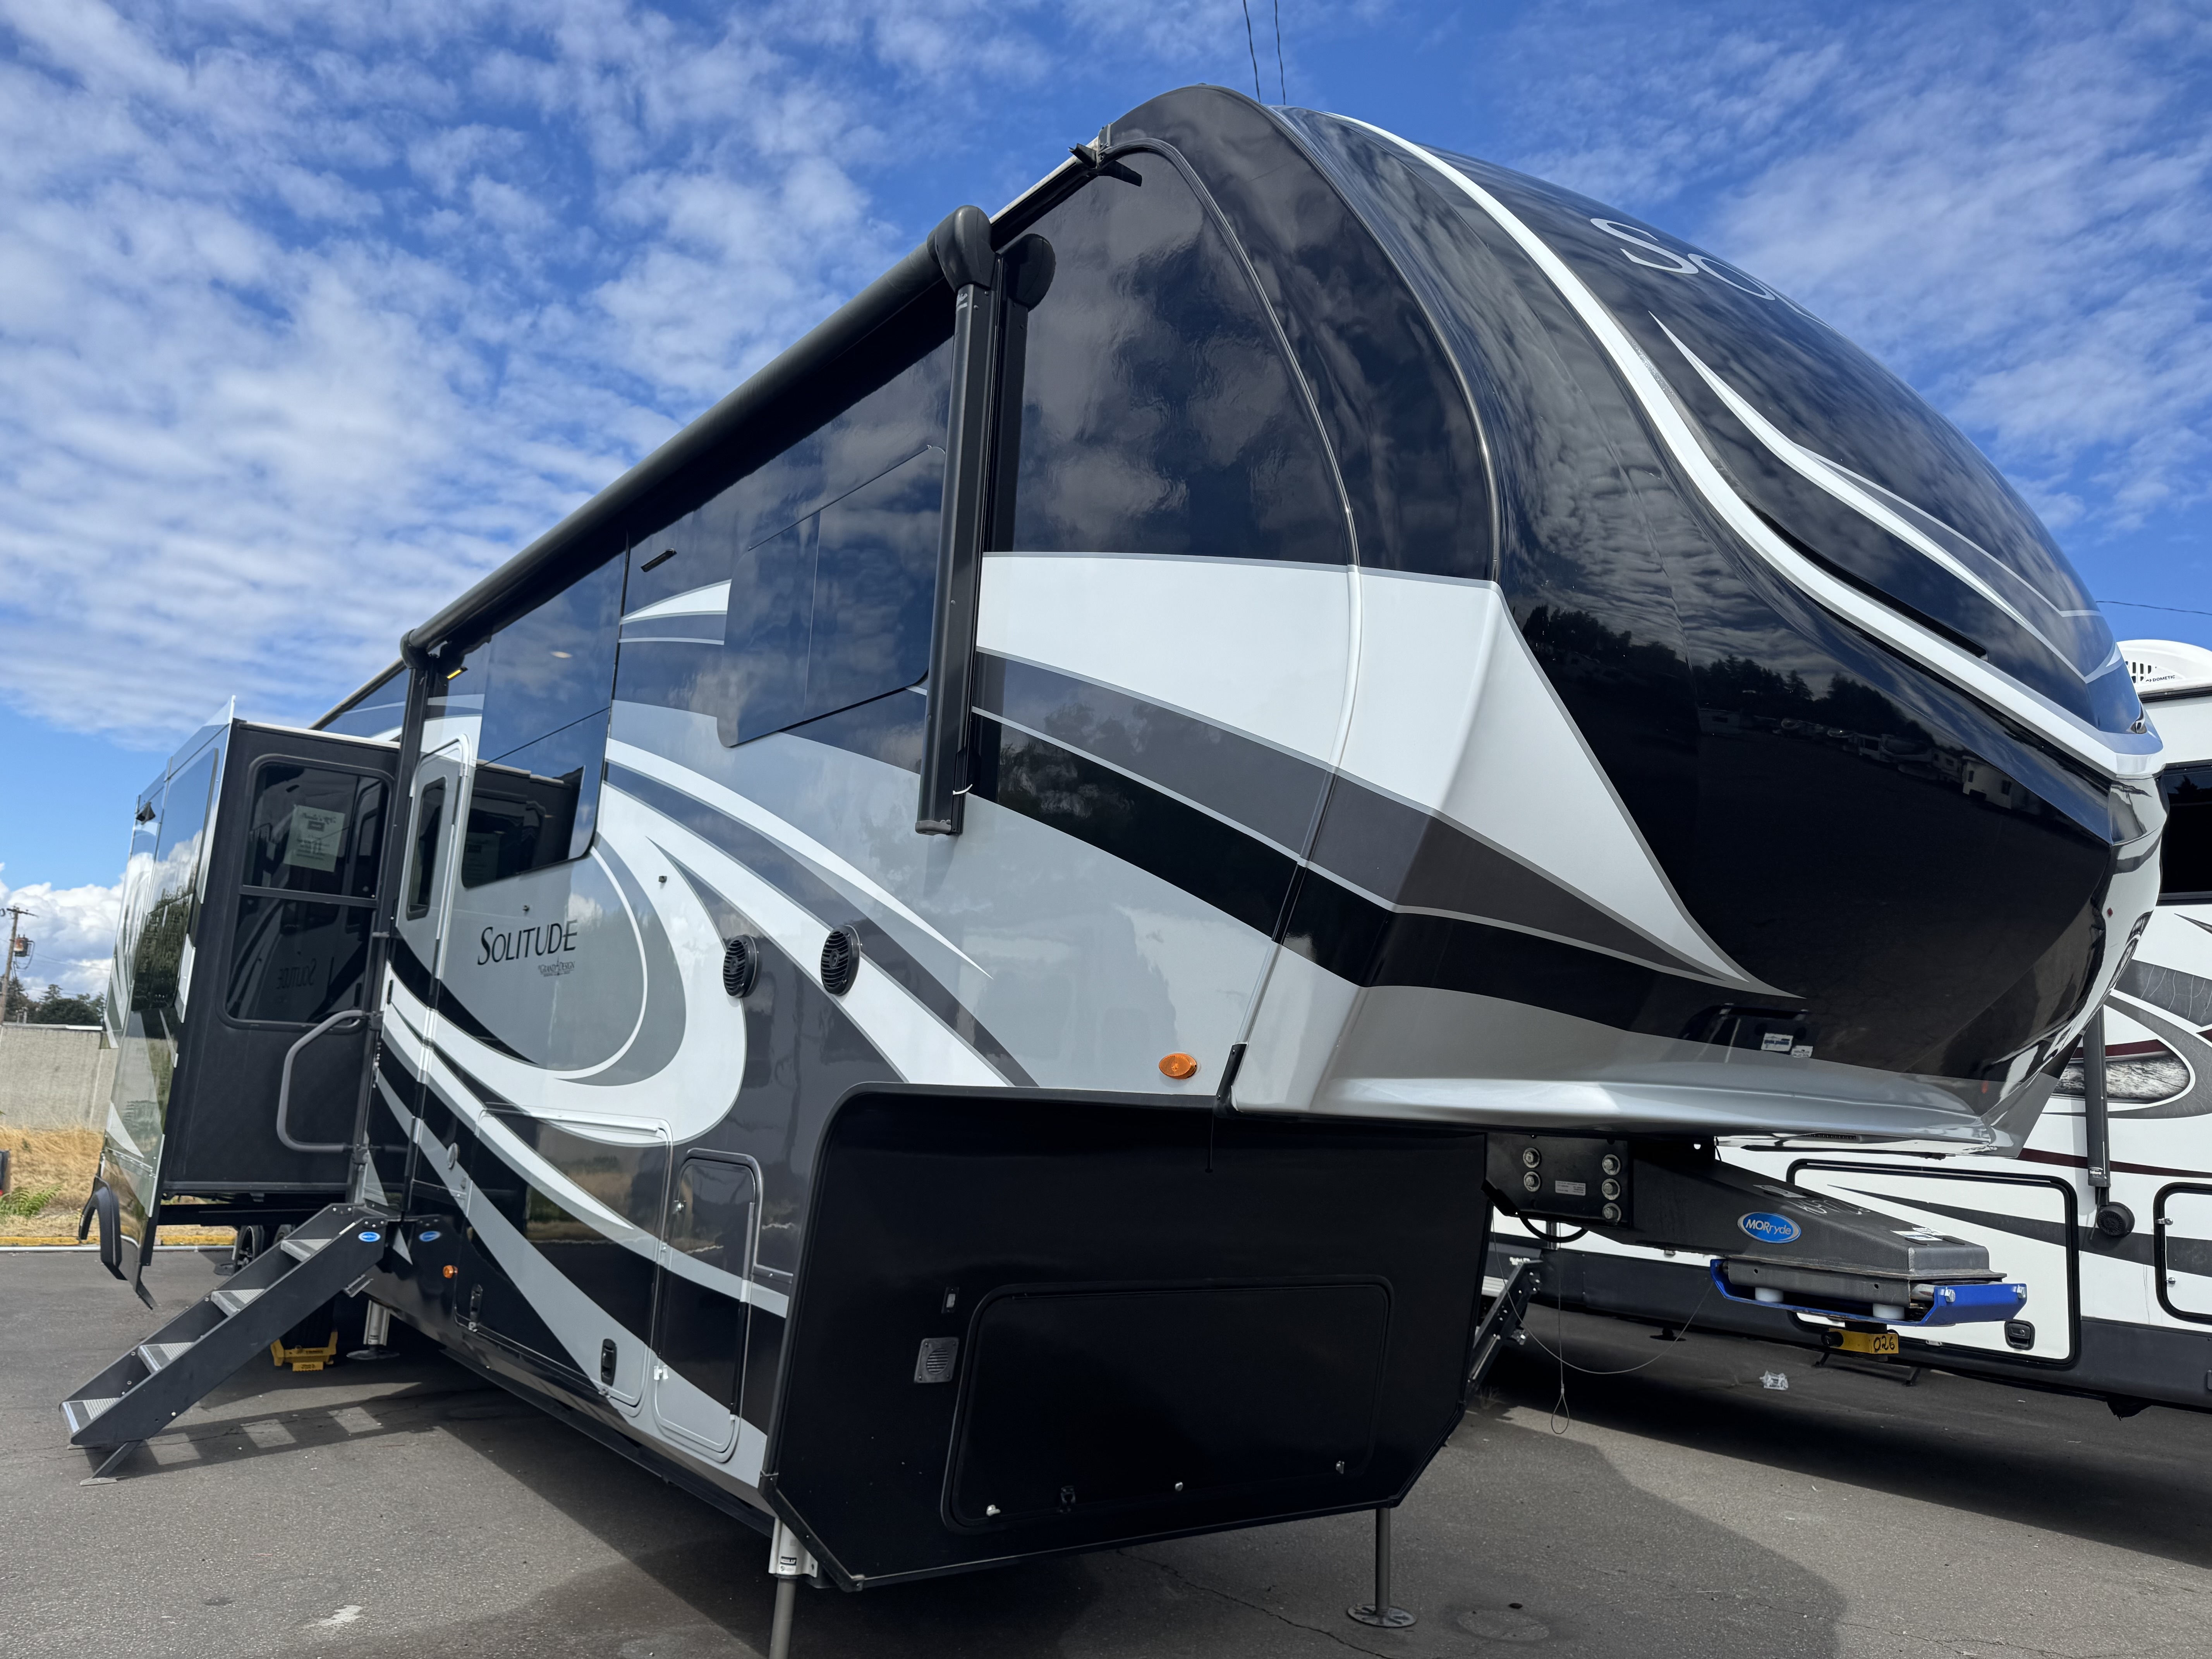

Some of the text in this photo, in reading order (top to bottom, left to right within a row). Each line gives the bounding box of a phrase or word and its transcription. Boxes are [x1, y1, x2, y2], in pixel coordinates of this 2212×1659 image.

[477, 919, 577, 965] SOLITUDE
[1745, 1219, 1791, 1235] MORryde
[1874, 1335, 1895, 1352] 026
